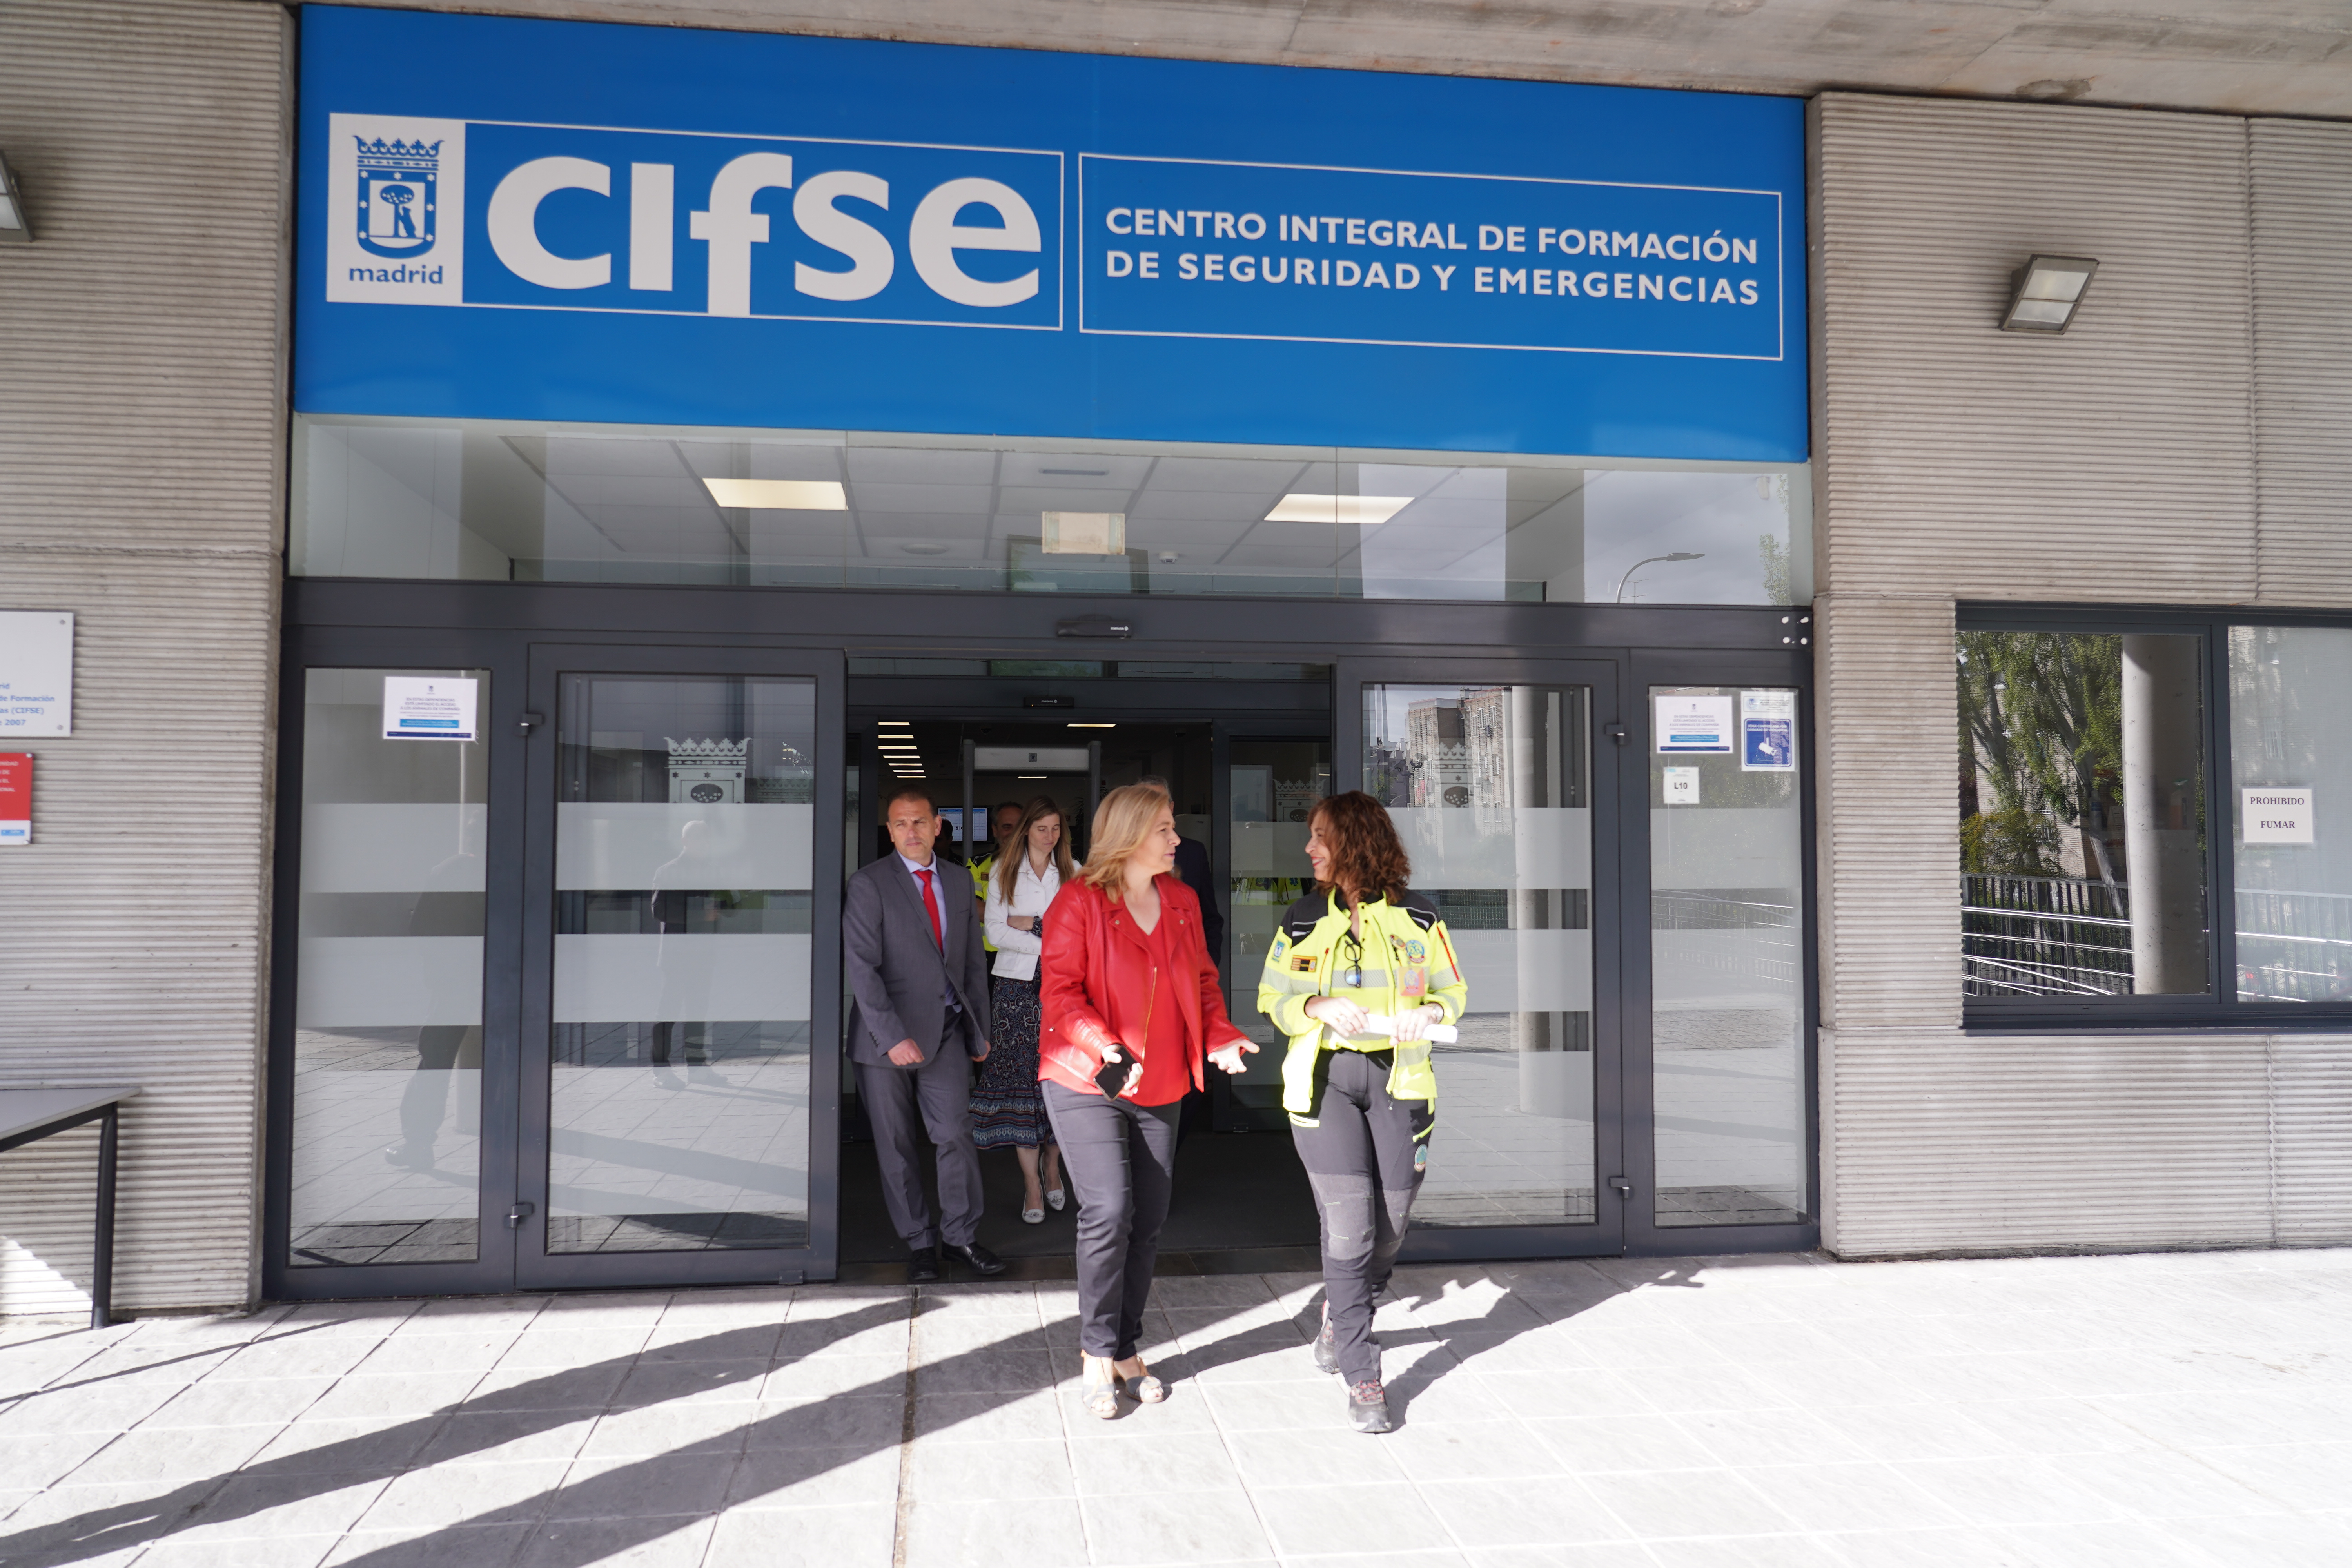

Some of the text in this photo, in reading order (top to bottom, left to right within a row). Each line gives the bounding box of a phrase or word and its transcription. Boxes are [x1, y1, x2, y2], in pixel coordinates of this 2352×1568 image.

[1106, 207, 1757, 264] CENTRO INTEGRAL DE FORMACIÓN
[349, 263, 443, 285] madrid
[1107, 250, 1758, 305] DE SEGURIDAD Y EMERGENCIAS
[2250, 797, 2304, 805] PROHIBIDO
